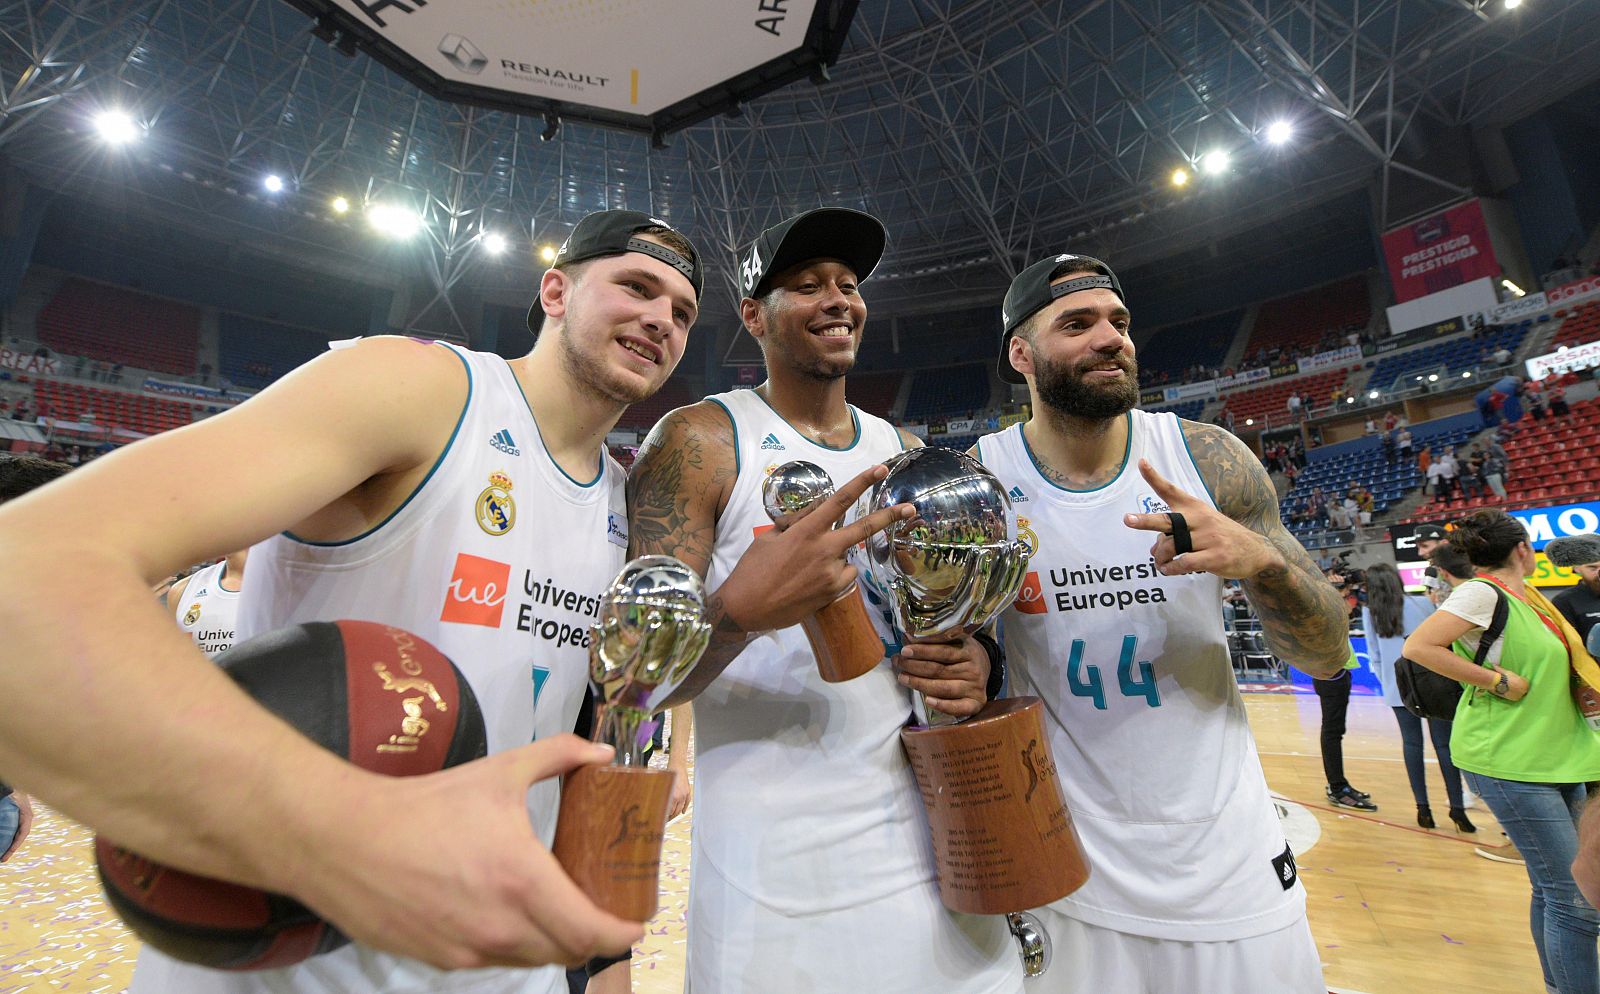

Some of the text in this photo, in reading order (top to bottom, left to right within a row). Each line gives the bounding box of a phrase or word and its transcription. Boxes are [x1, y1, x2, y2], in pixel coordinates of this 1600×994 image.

[500, 59, 610, 87] RENAULT
[503, 70, 548, 85] Passion
[549, 77, 566, 88] for
[742, 246, 763, 292] 34
[950, 422, 969, 431] CPA
[489, 438, 521, 457] adidas
[760, 443, 786, 451] adidas
[1050, 557, 1206, 588] Universi
[1055, 586, 1168, 612] Europea
[1066, 634, 1162, 710] 44
